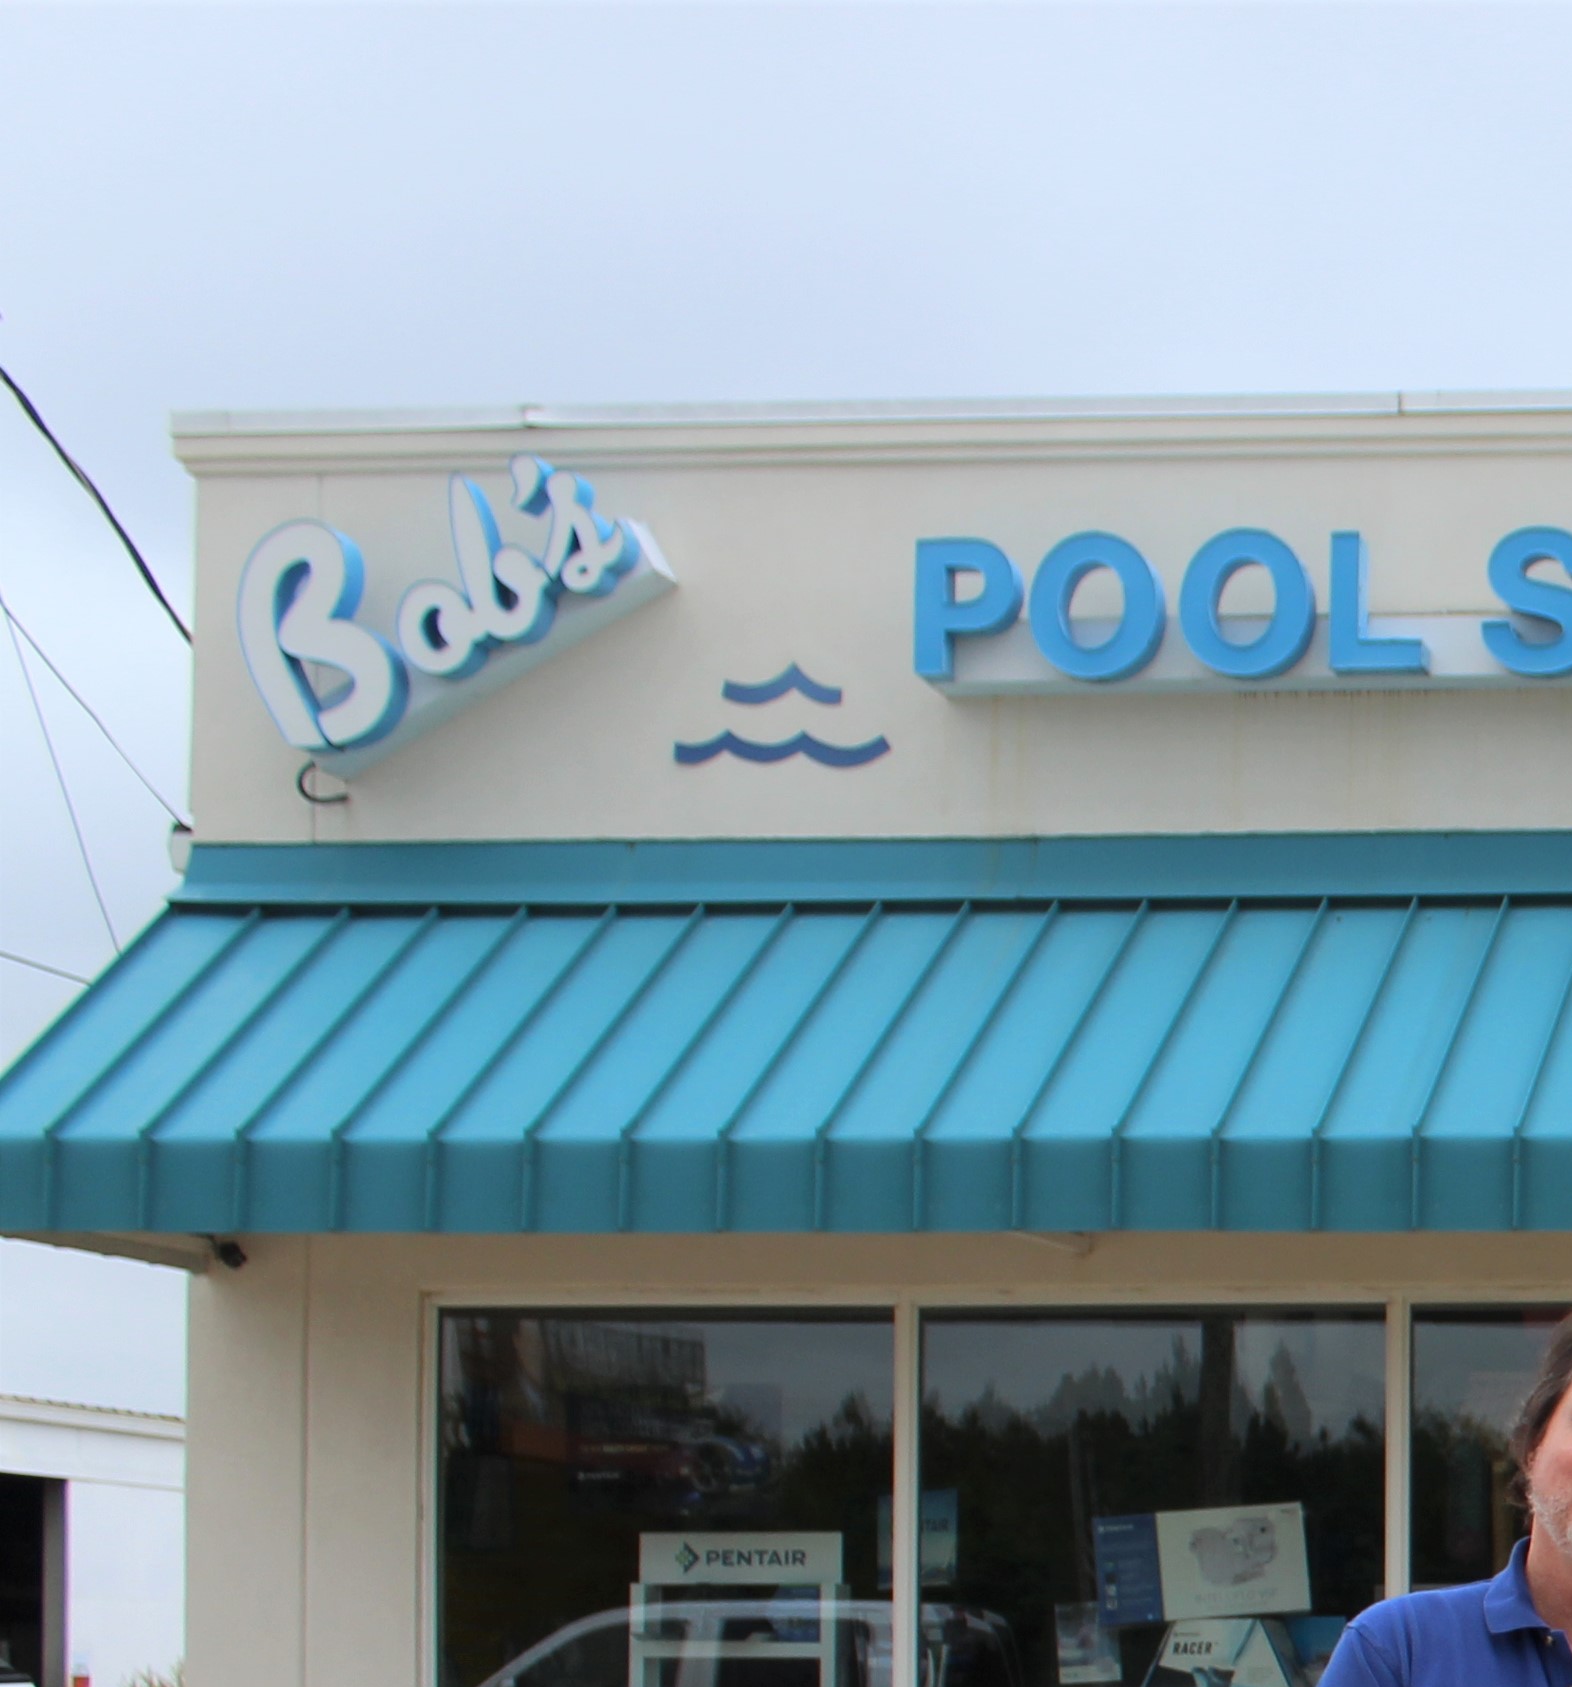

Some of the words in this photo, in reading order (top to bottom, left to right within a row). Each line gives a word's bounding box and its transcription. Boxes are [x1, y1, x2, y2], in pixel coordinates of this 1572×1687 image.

[237, 451, 637, 753] Bob's
[913, 527, 1429, 681] POOL
[704, 1549, 807, 1567] PENTAIR
[1173, 1641, 1213, 1655] RACER
